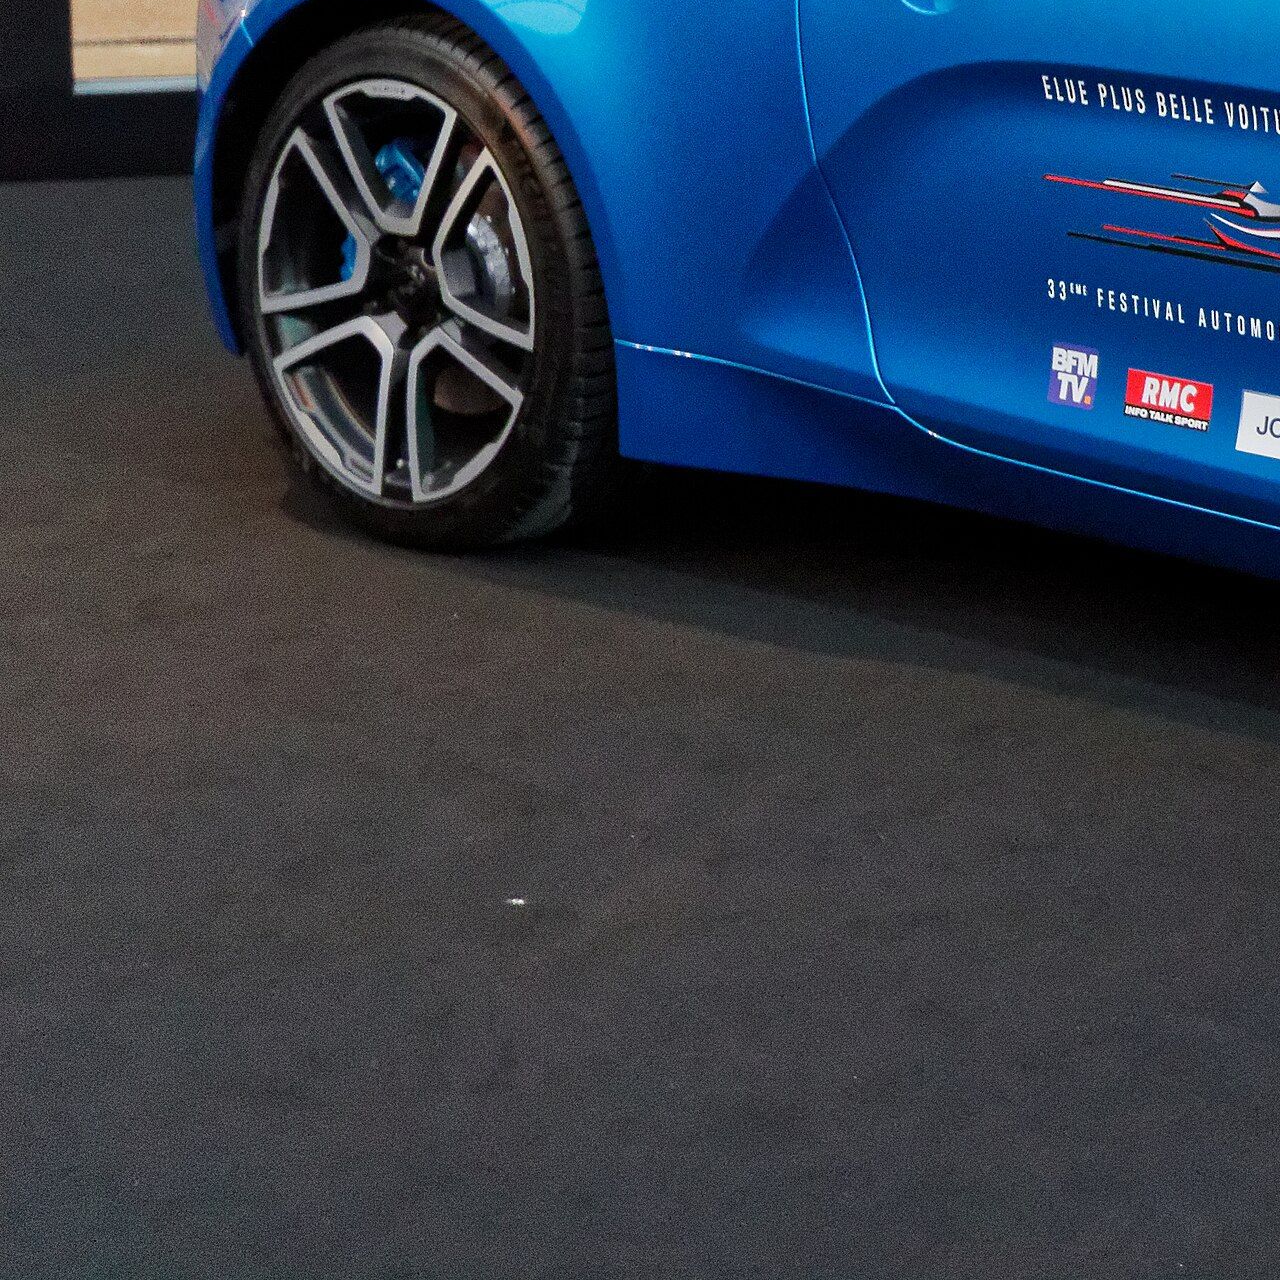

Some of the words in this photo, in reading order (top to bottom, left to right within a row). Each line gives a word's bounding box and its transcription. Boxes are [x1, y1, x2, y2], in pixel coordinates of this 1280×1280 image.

[1042, 75, 1088, 105] ELUE
[1098, 83, 1146, 114] PLUS
[1156, 91, 1214, 124] BELLE
[1097, 288, 1185, 324] FESTIVAL
[1051, 346, 1098, 379] BFM
[1142, 376, 1198, 413] RMC
[1125, 405, 1148, 417] INFO
[1149, 410, 1173, 424] TALK
[1174, 415, 1209, 431] SPORT
